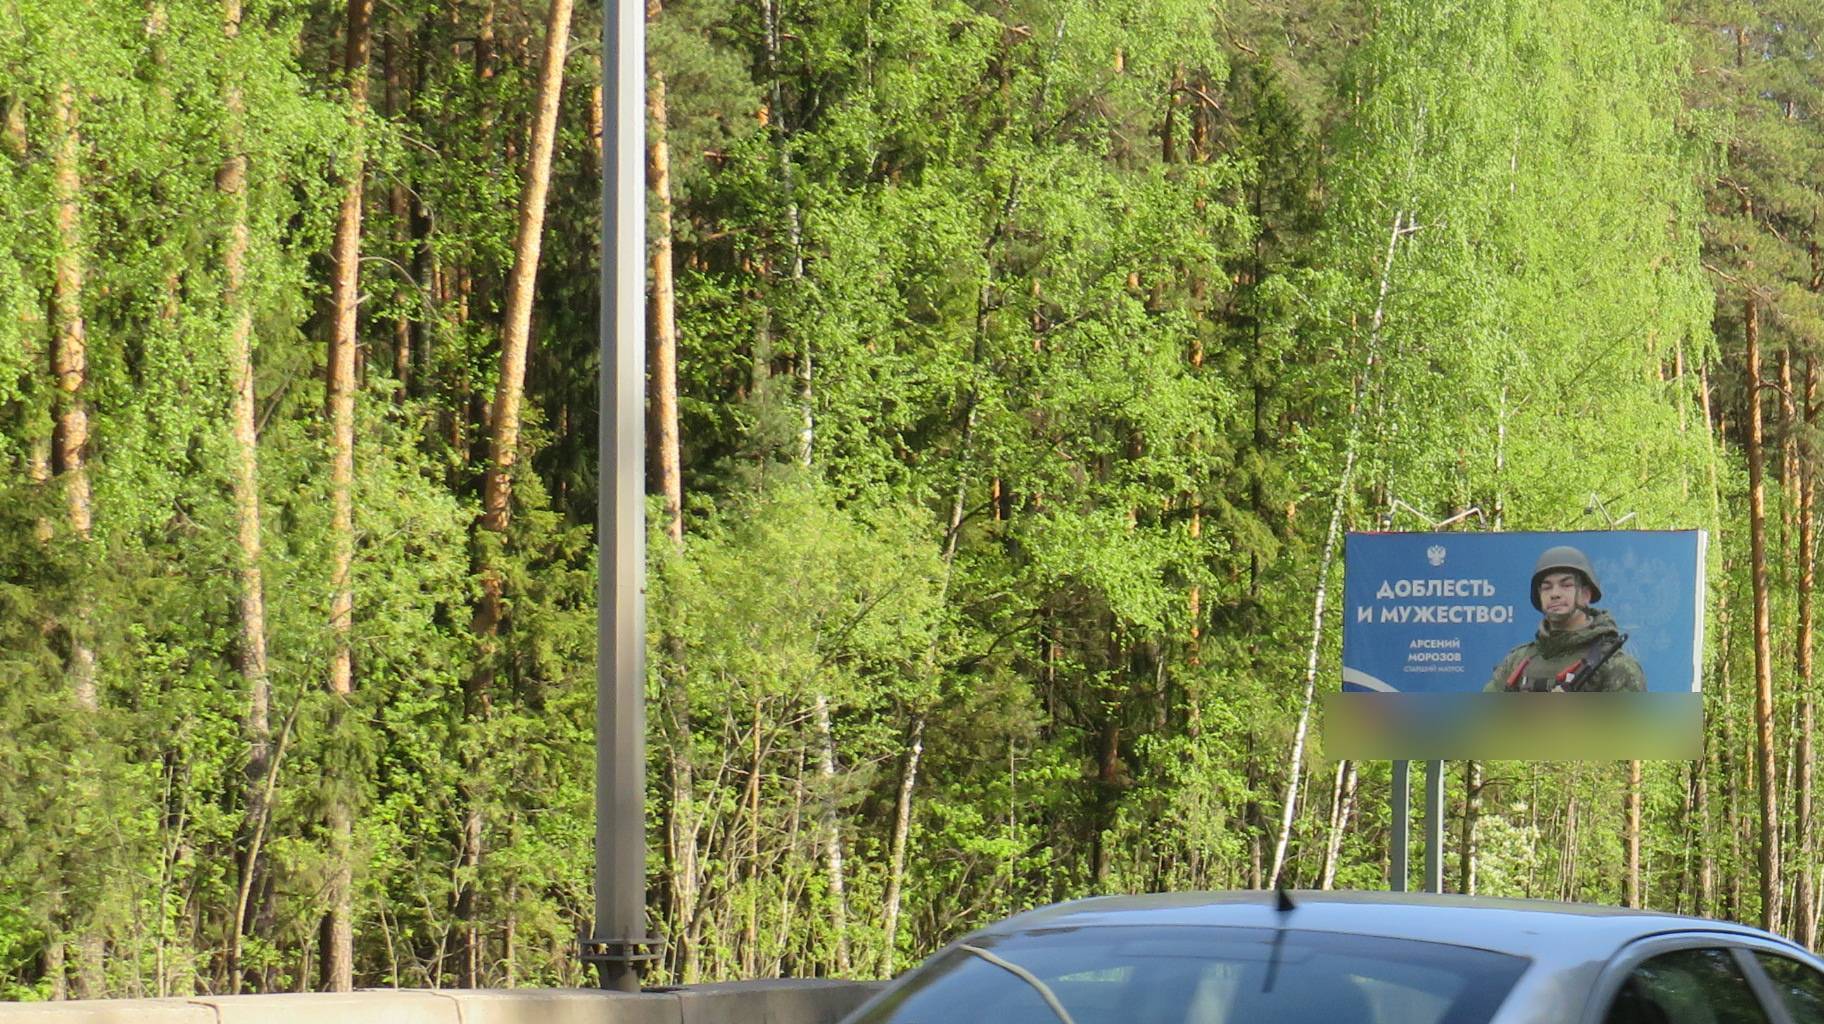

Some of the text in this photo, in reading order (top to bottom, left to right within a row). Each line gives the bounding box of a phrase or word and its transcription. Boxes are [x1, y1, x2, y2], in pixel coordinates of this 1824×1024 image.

[1377, 579, 1495, 599] ДОБЛЕСТЬ
[1358, 605, 1513, 623] И МУЖЕСТВО!
[1409, 637, 1461, 648] АРСЕНИЙ
[1407, 652, 1462, 662] МОРОЗОВ
